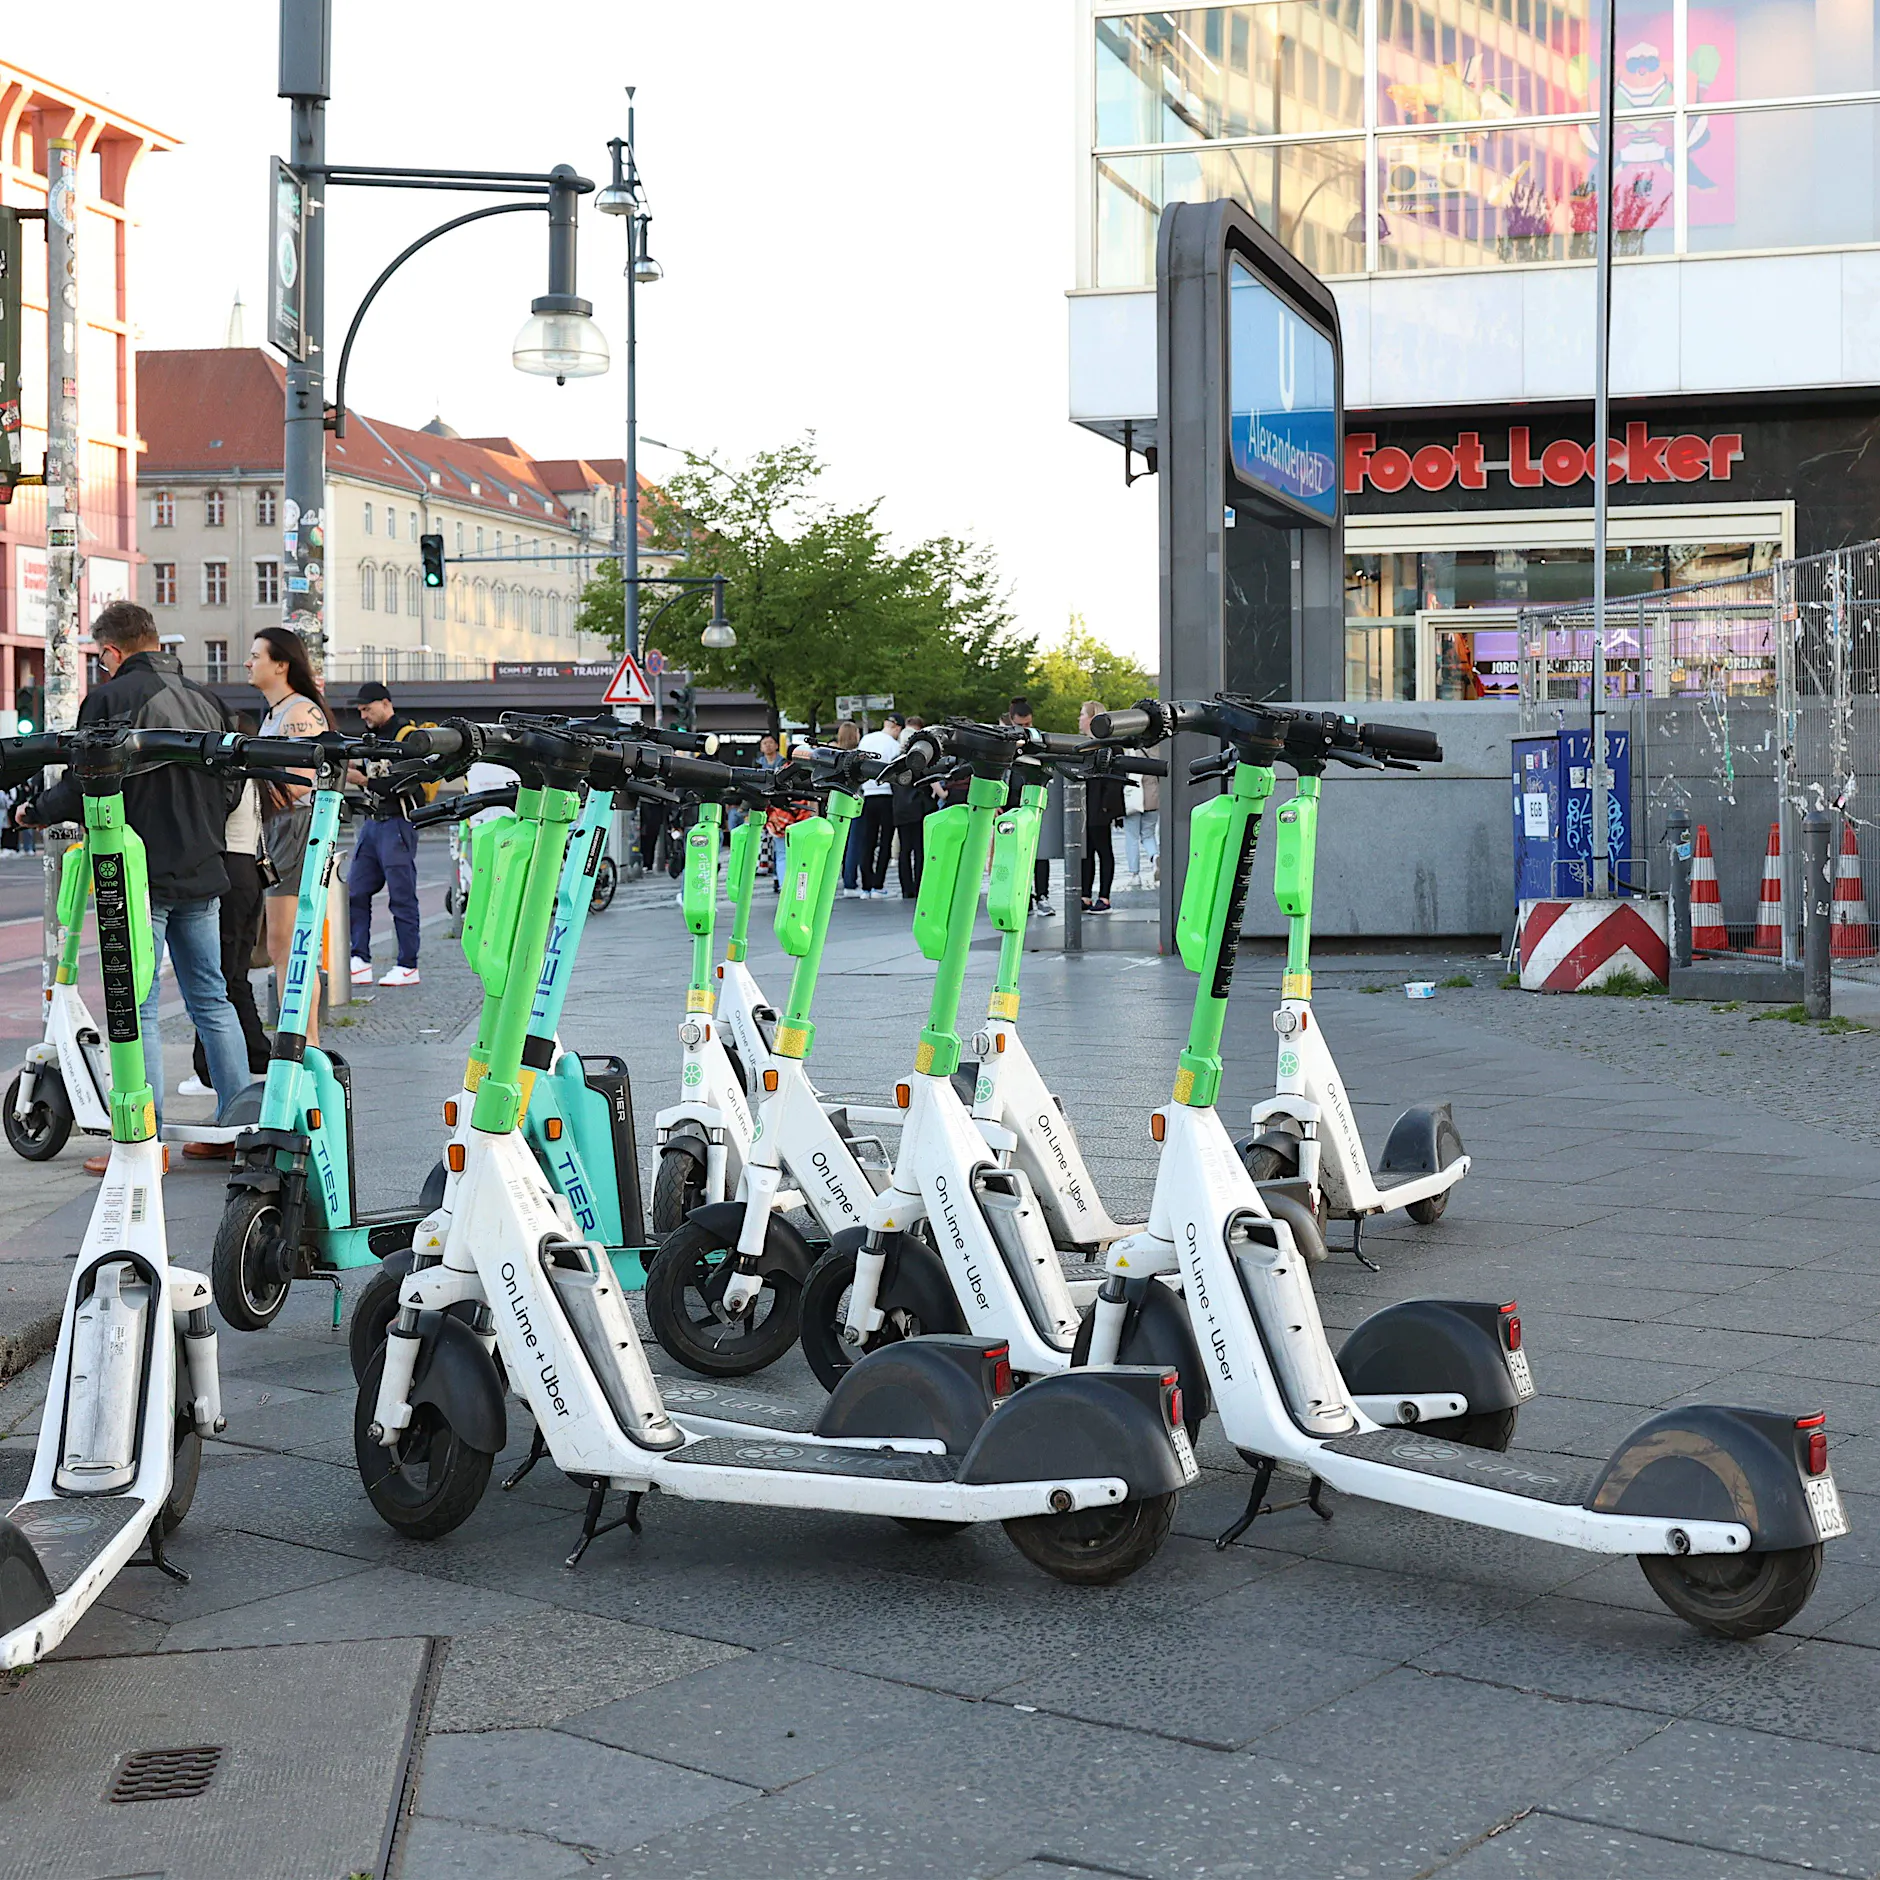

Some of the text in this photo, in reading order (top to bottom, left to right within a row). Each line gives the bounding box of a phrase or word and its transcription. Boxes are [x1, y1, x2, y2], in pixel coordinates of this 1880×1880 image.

[1279, 310, 1295, 412] U
[1249, 408, 1323, 497] Alexanderplatz
[1344, 422, 1743, 494] Foot Locker
[537, 667, 559, 677] ZIEL
[281, 928, 311, 1025] TIER
[615, 1085, 626, 1123] TIER
[727, 1088, 737, 1108] On
[734, 1107, 749, 1137] Lime
[1327, 1083, 1338, 1104] On
[1335, 1102, 1349, 1135] Lime
[1350, 1143, 1361, 1175] Uber
[318, 1139, 338, 1217] TIER
[559, 1151, 595, 1234] TIER
[812, 1152, 830, 1178] On
[825, 1174, 853, 1214] Lime
[1038, 1115, 1052, 1138] On
[1049, 1135, 1068, 1170] Lime
[1069, 1179, 1087, 1213] Uber
[936, 1175, 948, 1204] On
[943, 1204, 965, 1250] Lime
[966, 1265, 990, 1310] Uber
[1186, 1222, 1197, 1256] On
[1191, 1257, 1210, 1310] Lime
[501, 1262, 518, 1296] On
[511, 1295, 537, 1348] Lime
[540, 1364, 570, 1417] Uber
[1211, 1328, 1234, 1382] Uber
